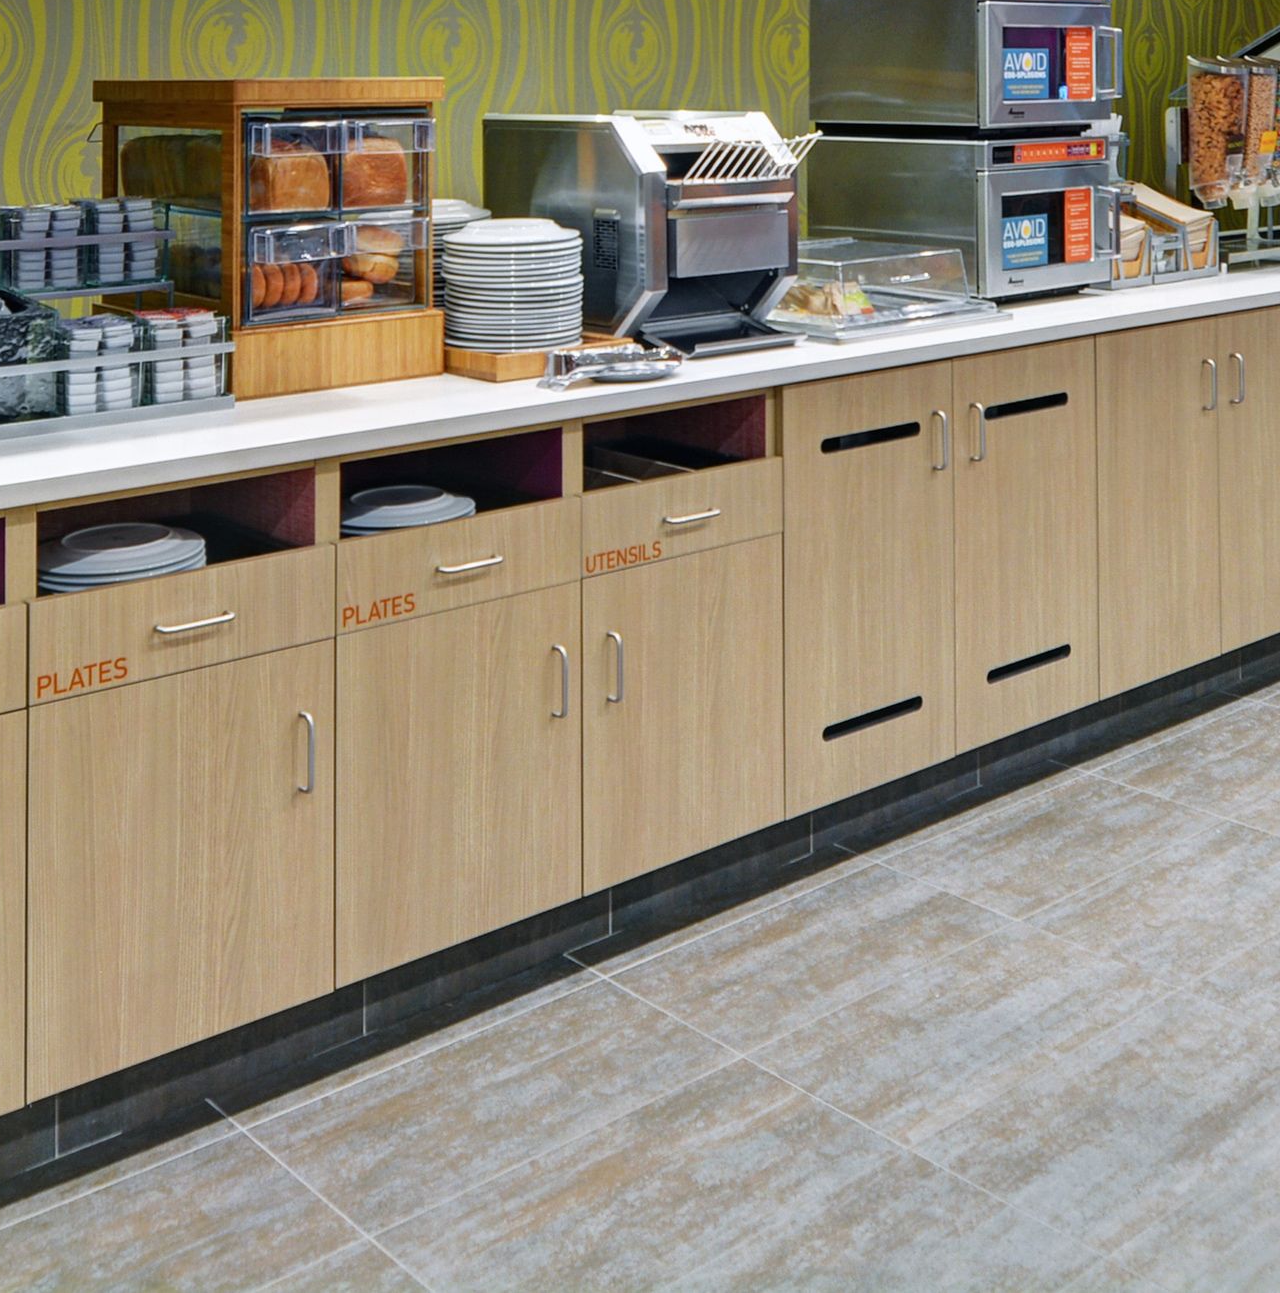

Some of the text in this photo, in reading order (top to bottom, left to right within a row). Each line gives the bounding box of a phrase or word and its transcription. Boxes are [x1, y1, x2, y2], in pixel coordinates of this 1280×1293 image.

[1004, 52, 1047, 72] AVOID
[1003, 219, 1046, 241] AVOID
[585, 540, 662, 574] UTENSILS
[341, 593, 416, 628] PLATES
[35, 657, 129, 699] PLATES
